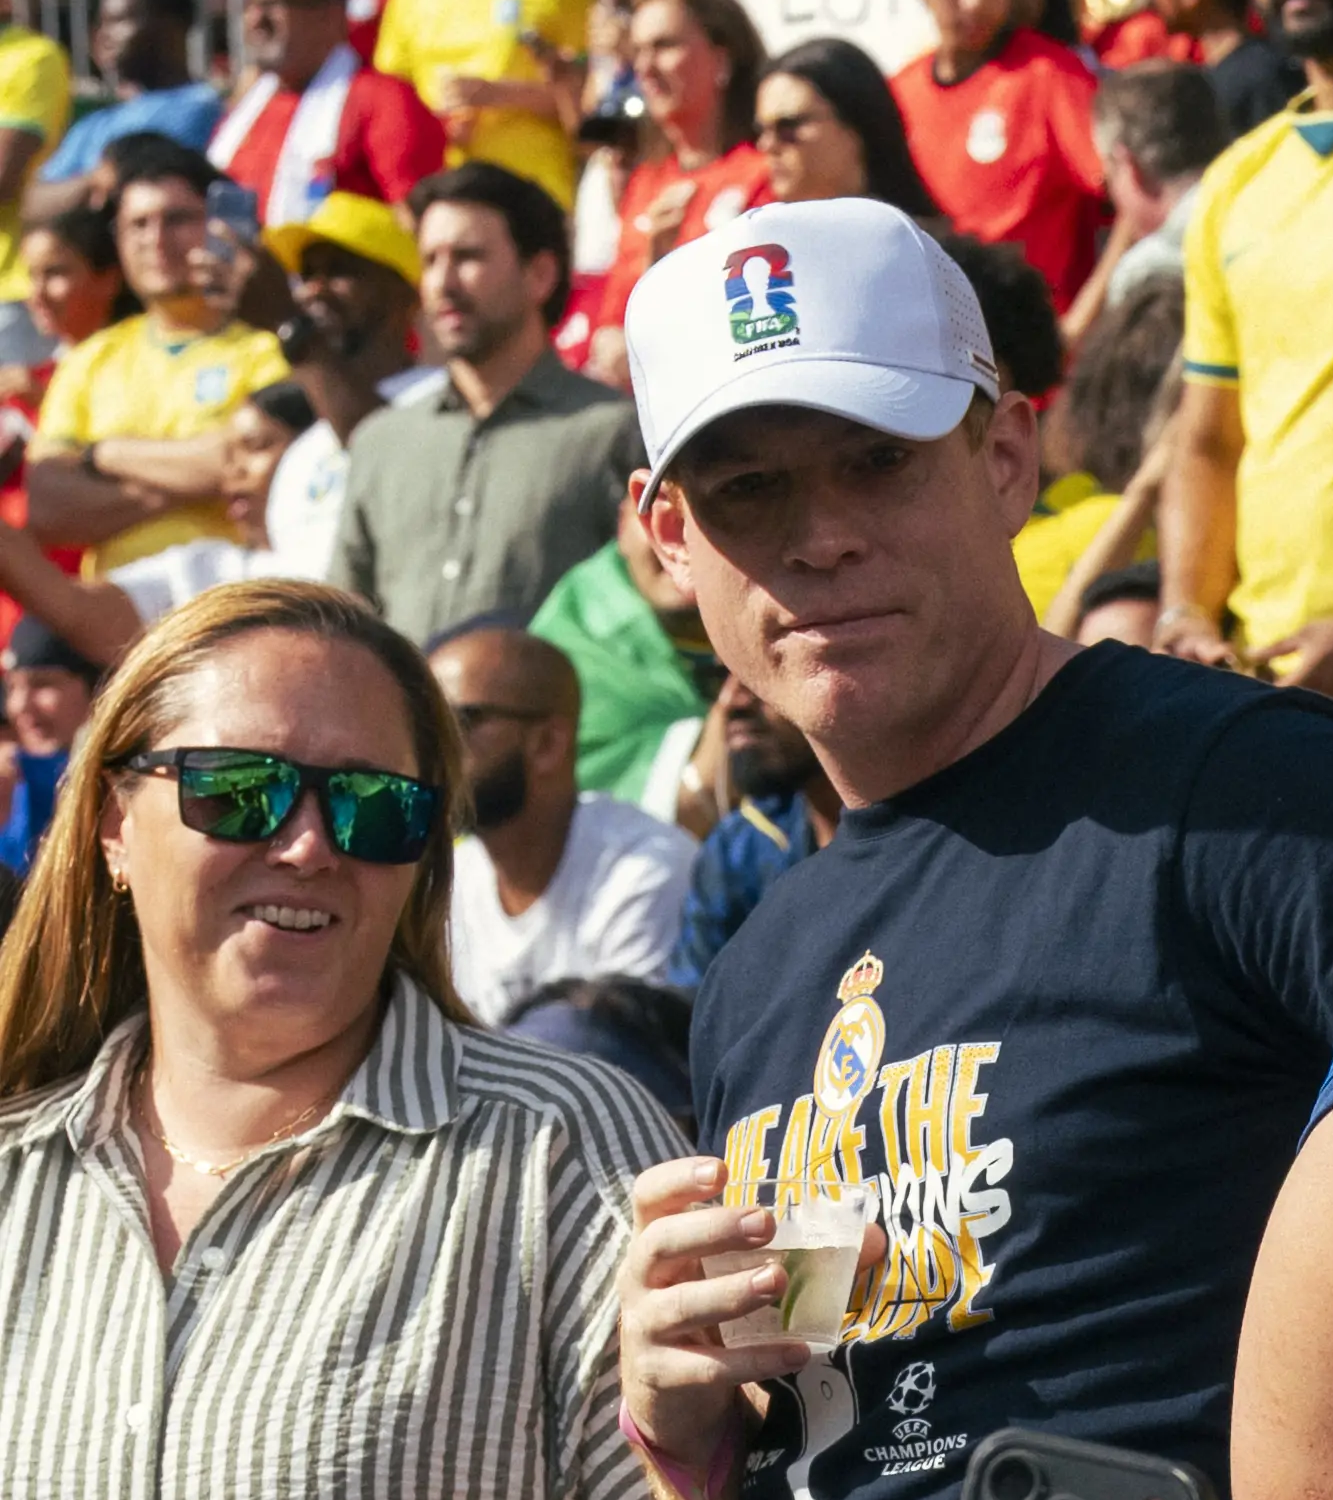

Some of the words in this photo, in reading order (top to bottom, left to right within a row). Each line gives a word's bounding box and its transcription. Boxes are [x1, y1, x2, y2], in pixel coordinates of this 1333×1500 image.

[876, 1041, 1001, 1190] THE
[893, 1421, 929, 1440] UEFA
[864, 1433, 968, 1462] CHAMPIONS
[881, 1453, 946, 1476] LEAGUE
